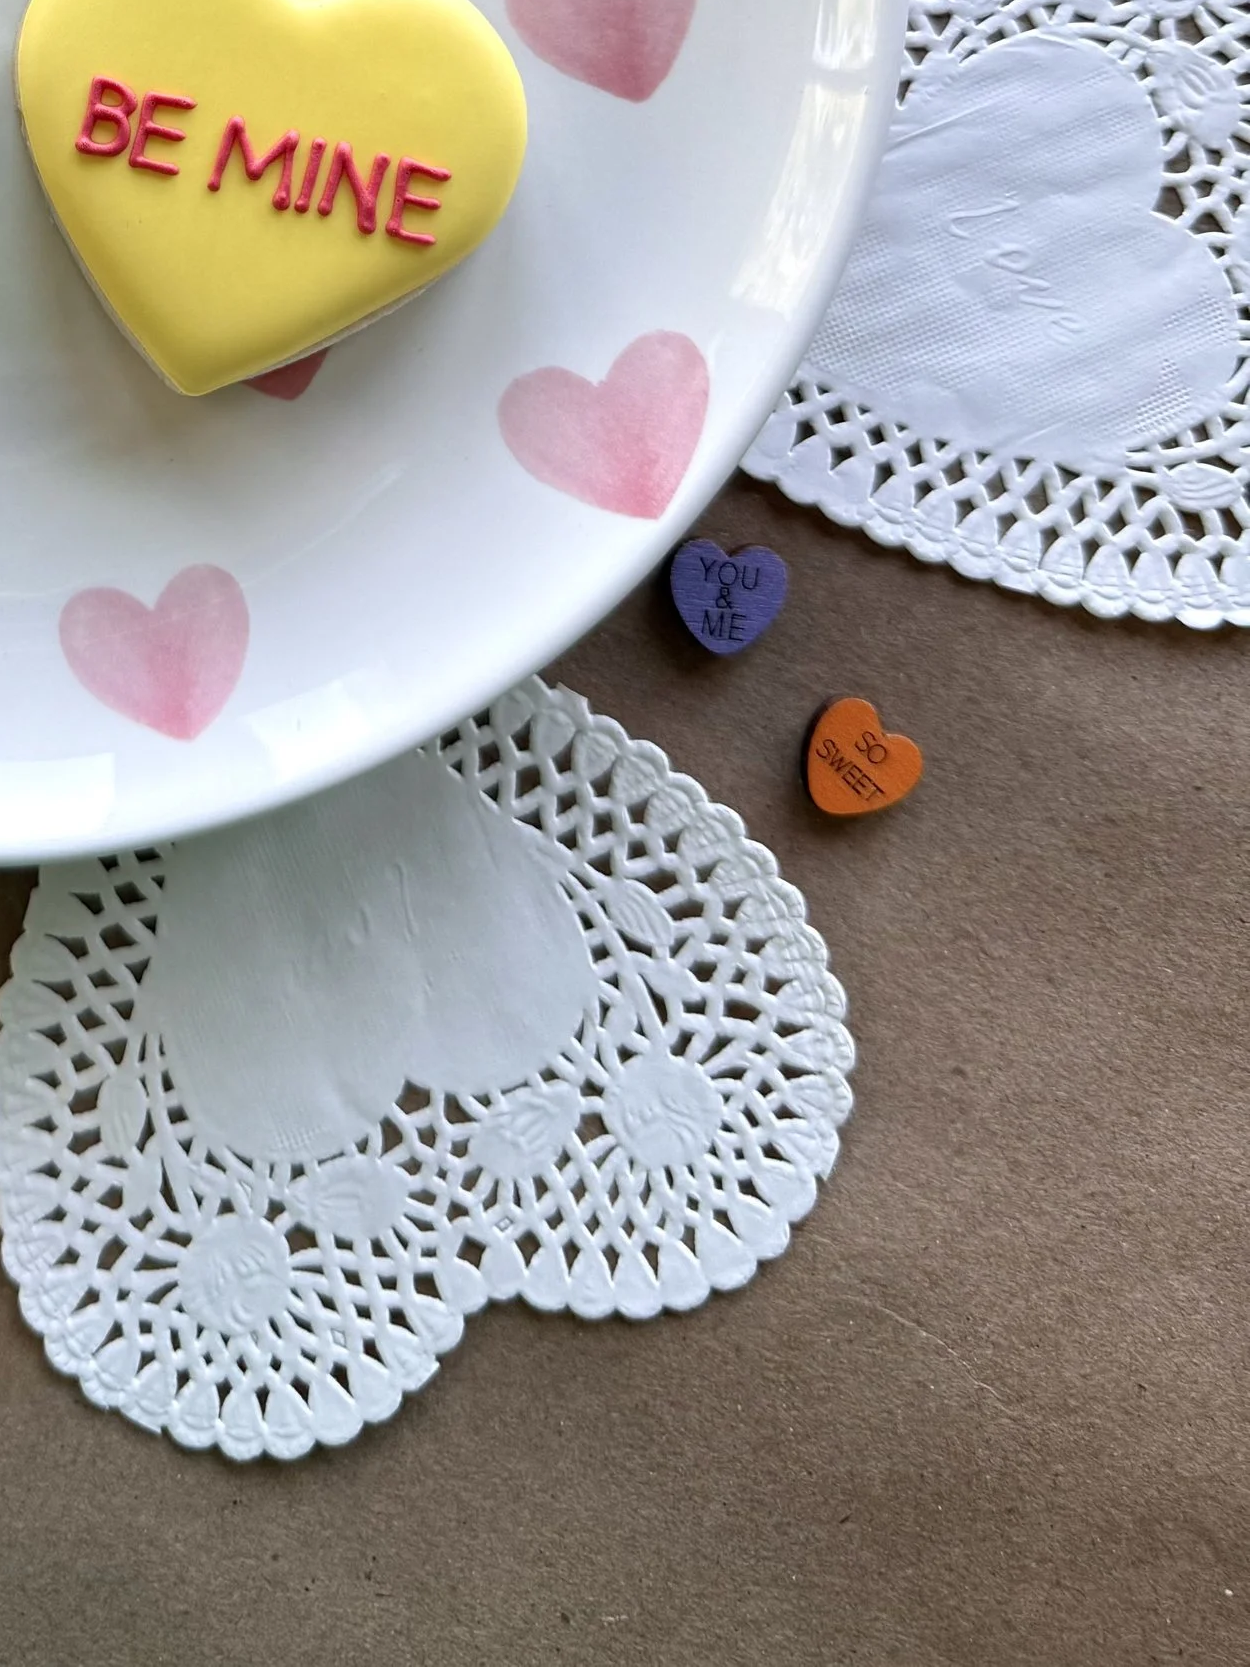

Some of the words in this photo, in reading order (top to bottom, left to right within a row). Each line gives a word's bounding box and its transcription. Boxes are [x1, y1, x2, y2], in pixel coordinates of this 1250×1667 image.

[75, 75, 197, 175] BE
[207, 115, 452, 246] MINE
[700, 556, 760, 589] YOU
[715, 586, 733, 610] &
[701, 611, 747, 641] ME
[855, 729, 888, 763] SO
[816, 739, 885, 801] SWEET
